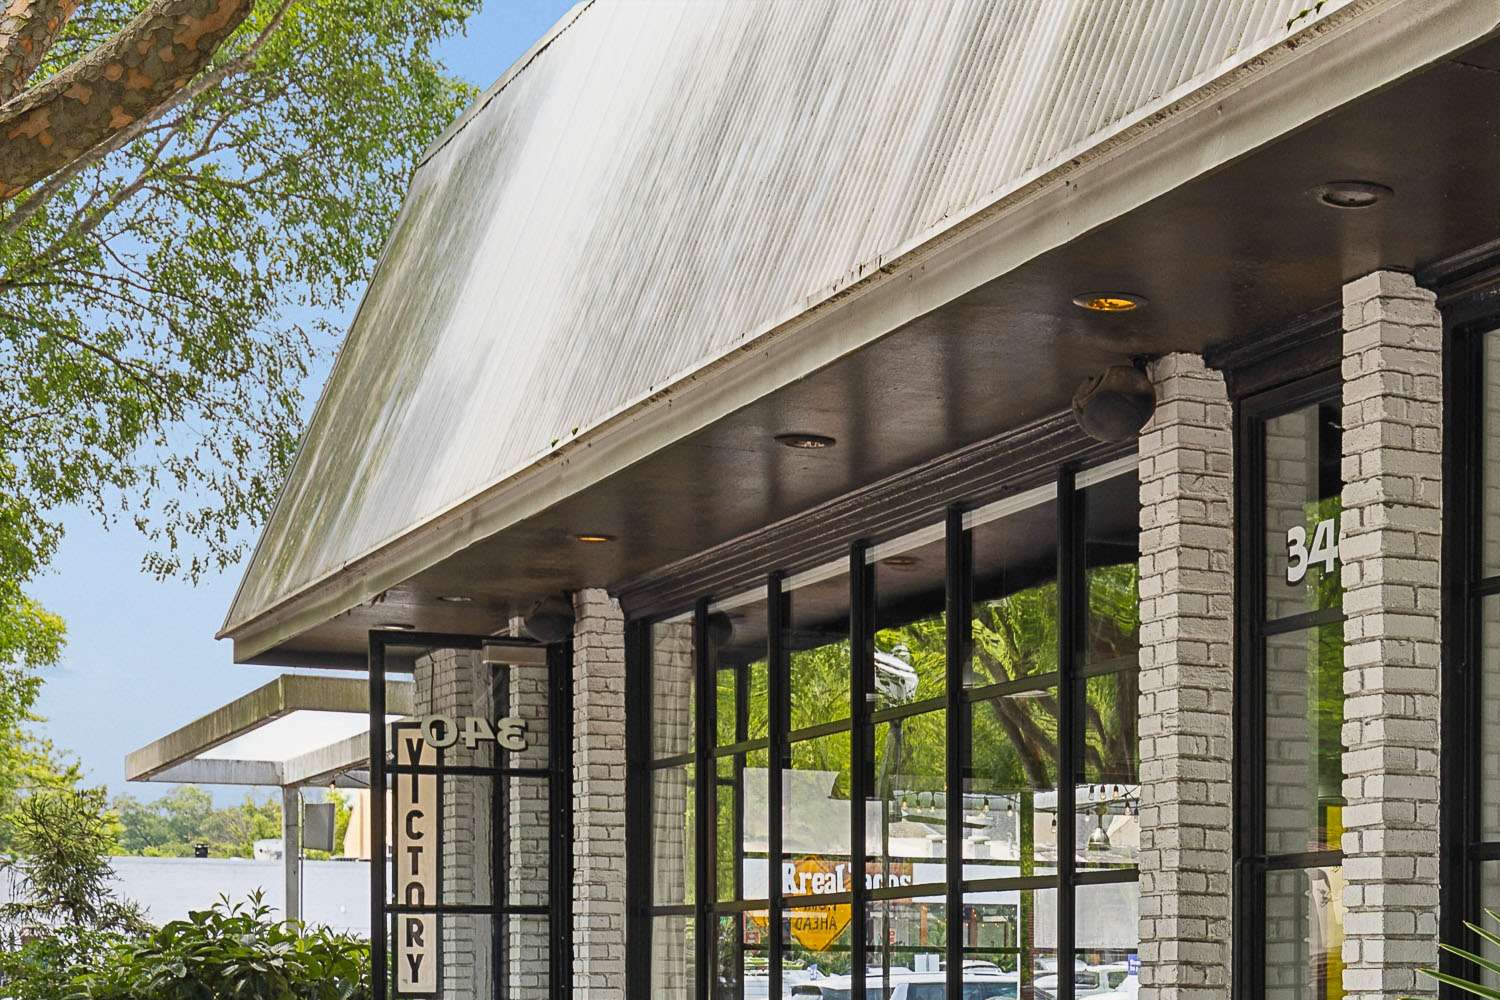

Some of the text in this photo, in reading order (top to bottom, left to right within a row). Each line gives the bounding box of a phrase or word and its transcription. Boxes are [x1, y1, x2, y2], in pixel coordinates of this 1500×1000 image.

[1286, 517, 1341, 587] 34
[404, 737, 425, 983] VICTORY
[848, 861, 912, 890] cos
